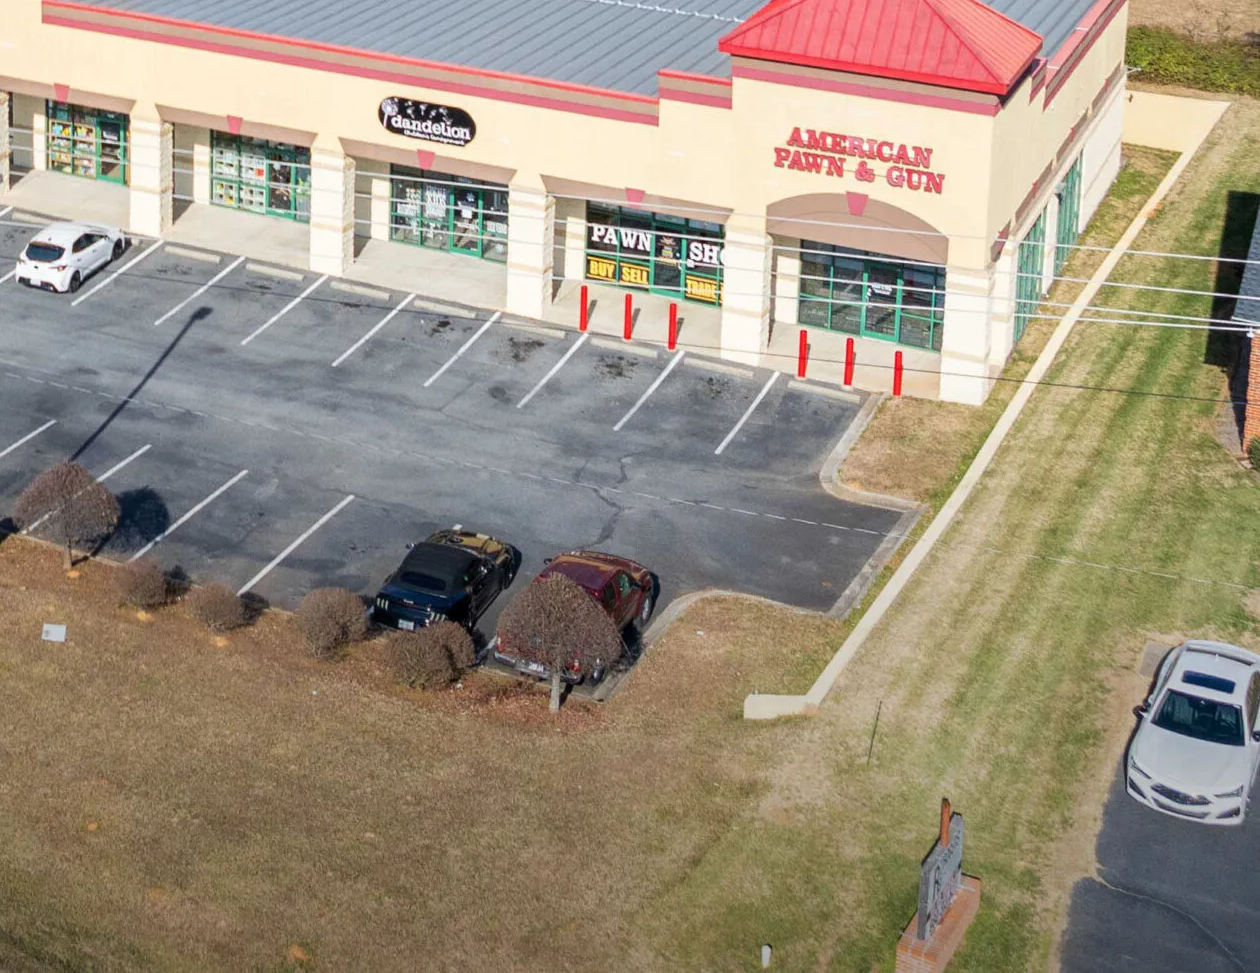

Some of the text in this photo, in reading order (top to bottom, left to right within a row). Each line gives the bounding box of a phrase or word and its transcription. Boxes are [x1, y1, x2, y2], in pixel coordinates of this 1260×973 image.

[390, 114, 471, 141] dandelion
[786, 126, 933, 169] AMERICAN
[774, 147, 945, 195] PAWN & GUN
[591, 225, 653, 252] PAWN
[688, 241, 724, 266] SH
[588, 259, 649, 285] BUY SELL
